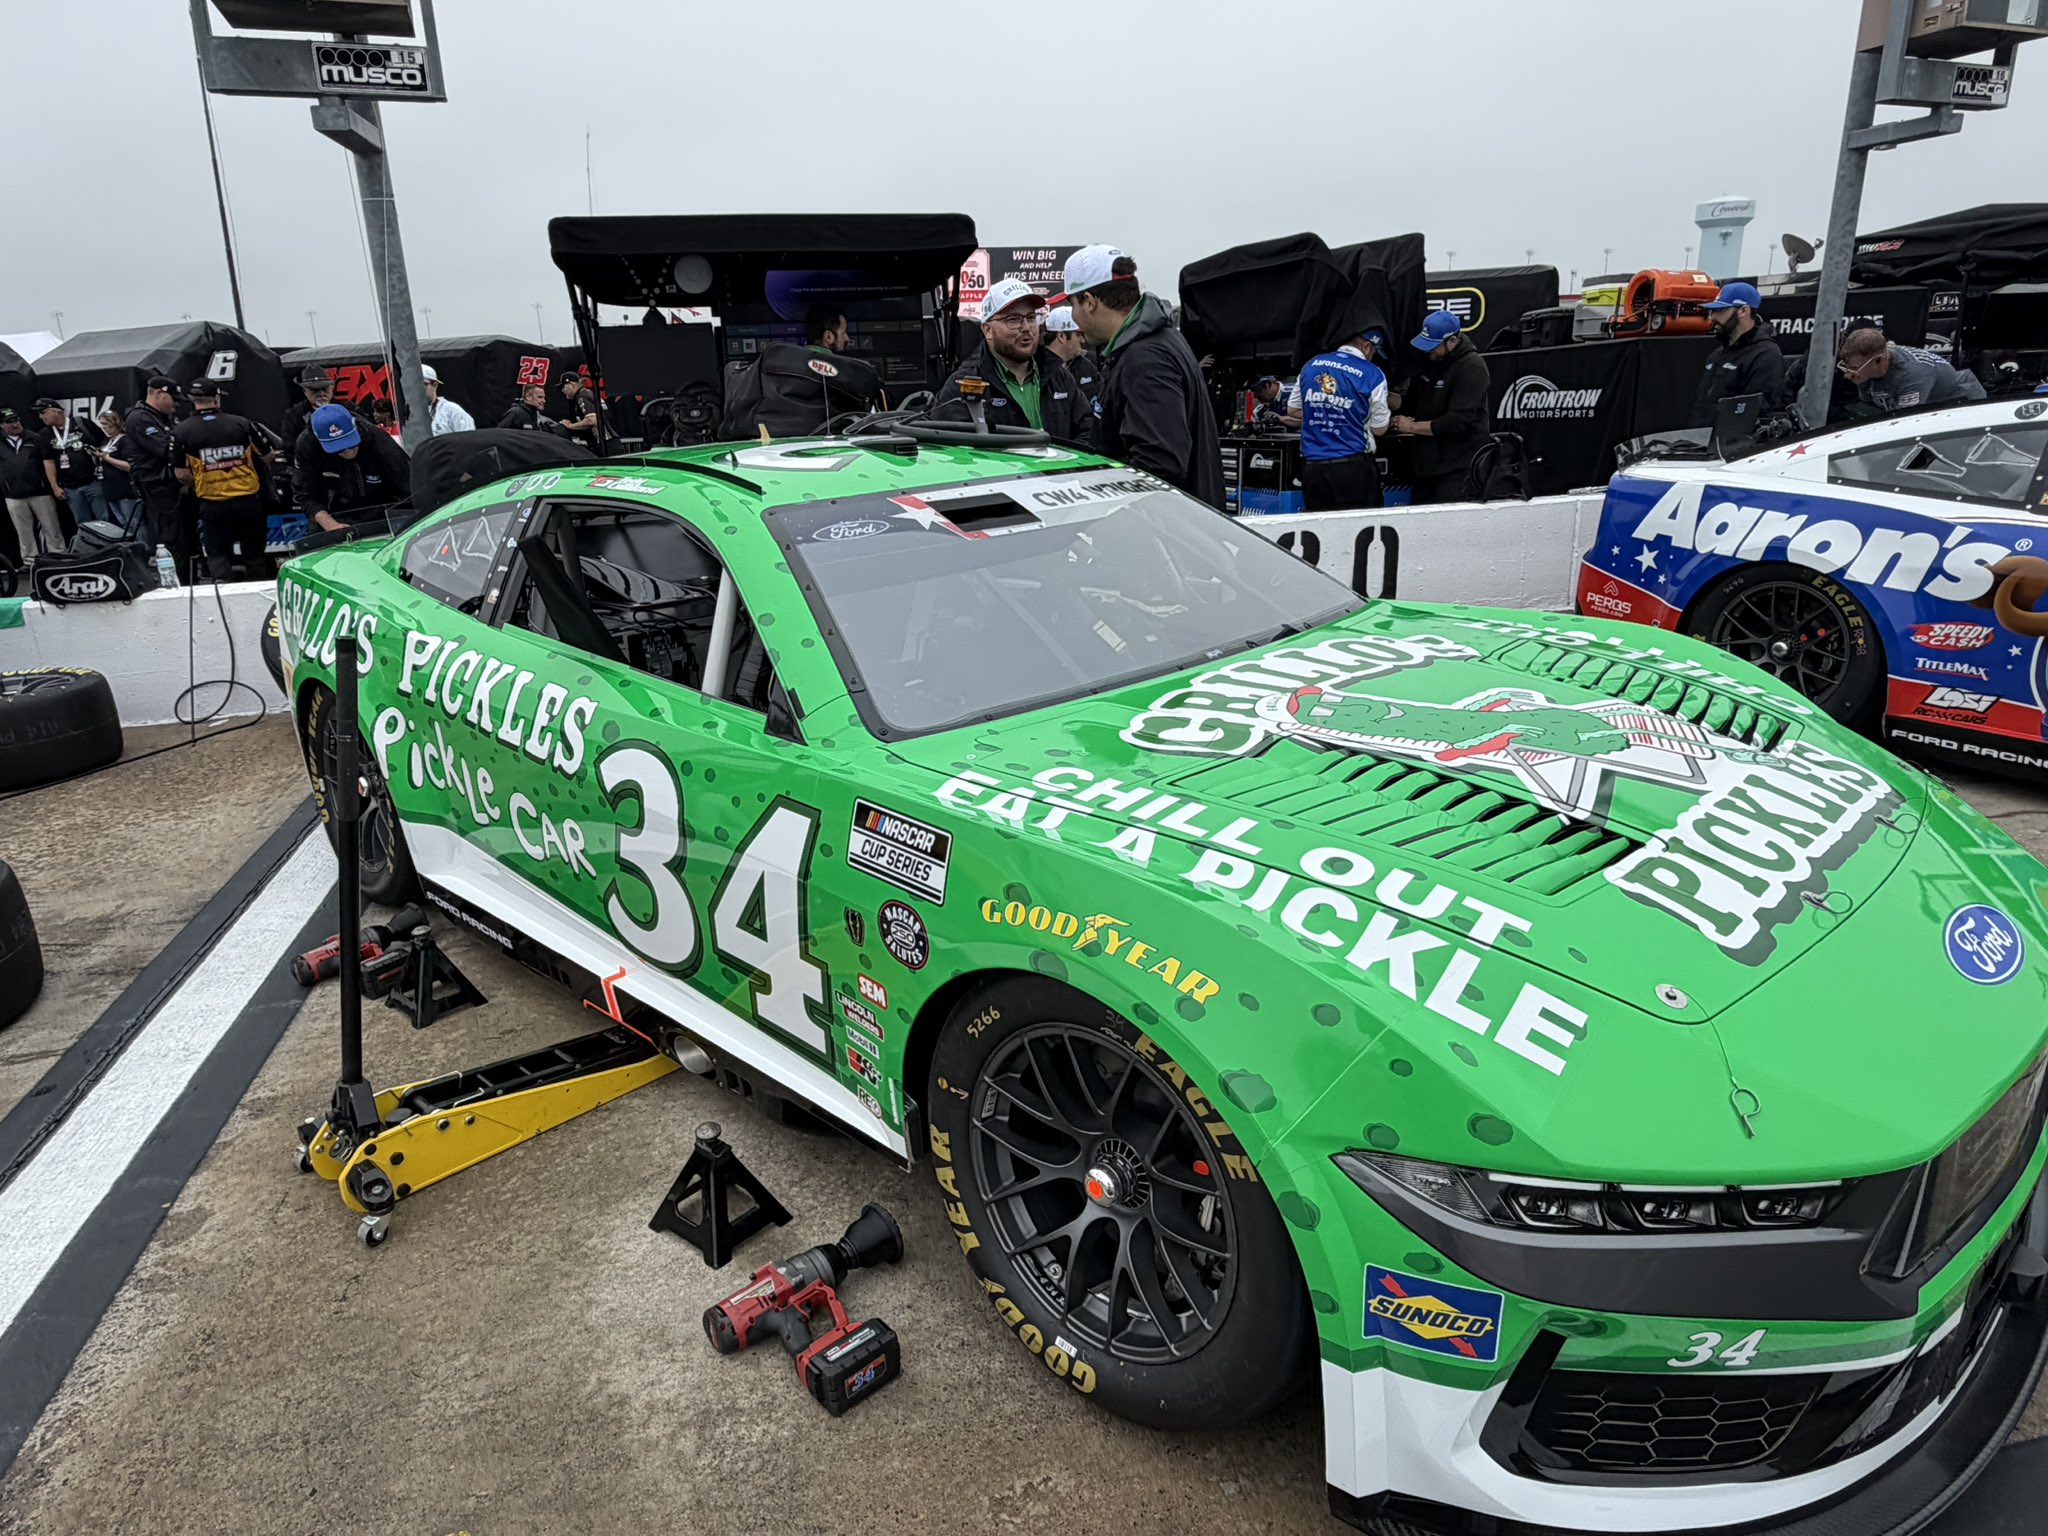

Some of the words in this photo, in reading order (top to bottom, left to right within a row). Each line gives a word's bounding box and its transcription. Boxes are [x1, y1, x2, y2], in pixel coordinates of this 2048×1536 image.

[1012, 251, 1034, 261] WIN
[1038, 250, 1057, 260] BIG
[1003, 271, 1026, 281] KIDS
[1028, 271, 1038, 280] IN
[208, 351, 237, 381] 6
[517, 356, 549, 385] 23
[811, 361, 834, 375] BELL
[1311, 359, 1363, 378] Aarons.com
[200, 446, 244, 464] RUSH
[1033, 489, 1086, 508] CW4
[829, 522, 878, 540] Ford
[1632, 481, 2012, 602] Aaron's
[1812, 574, 1863, 628] EAGLE
[1929, 624, 1994, 638] SPEEDY
[281, 577, 378, 674] GRILLO'S
[398, 629, 598, 776] PICKLES
[1924, 687, 1998, 713] LOSI
[1891, 729, 1958, 750] FORD
[881, 815, 936, 854] NASCAR
[1622, 743, 1881, 937] PICKLES
[861, 838, 886, 860] CUP
[886, 853, 932, 882] SERIES
[1030, 766, 1265, 855] CHILL
[1299, 846, 1533, 952] OUT
[598, 746, 829, 1056] 34
[426, 890, 461, 918] FORD
[461, 912, 514, 950] RACING
[884, 905, 922, 935] NASCAR
[928, 769, 1094, 841] EAT
[1097, 820, 1160, 867] A
[1178, 847, 1590, 1077] PICKLE
[885, 935, 923, 966] SALUTES
[1954, 915, 2014, 974] Ford
[836, 992, 875, 1024] LINCOLN
[858, 975, 886, 1009] SEM
[846, 1008, 880, 1037] WELDERS
[967, 1005, 1001, 1038] 5266
[847, 1027, 868, 1049] Mobil
[1135, 1033, 1258, 1183] EAGLE
[1373, 1296, 1493, 1339] SUNOCO
[1667, 1328, 1768, 1368] 34
